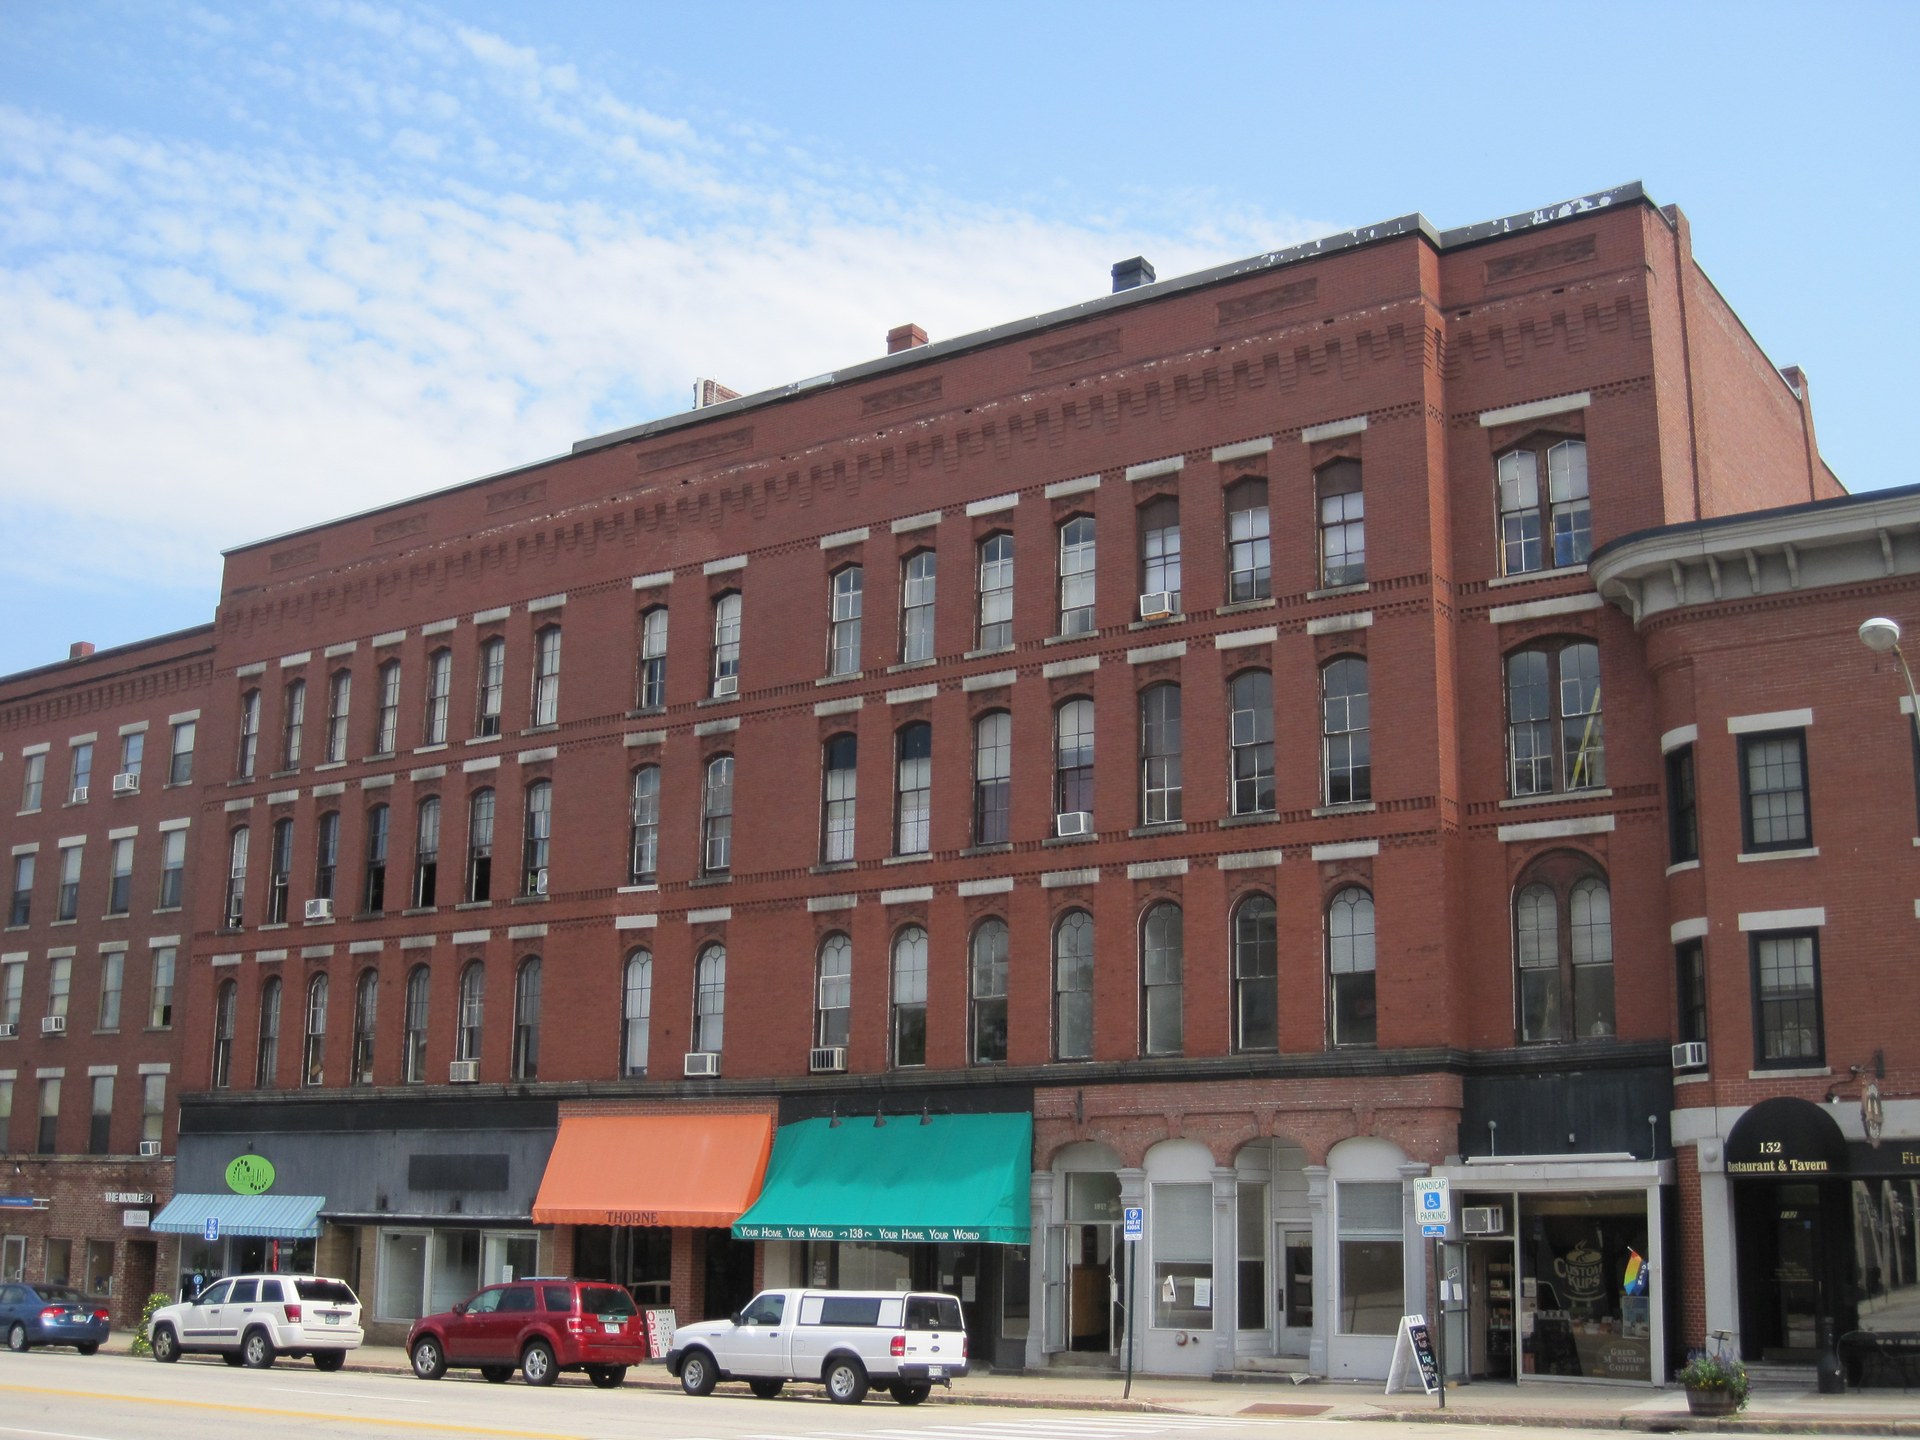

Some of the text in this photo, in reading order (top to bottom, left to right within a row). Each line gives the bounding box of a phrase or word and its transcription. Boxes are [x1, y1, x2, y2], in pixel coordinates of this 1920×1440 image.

[1759, 1142, 1781, 1153] 132
[1727, 1159, 1828, 1173] Restaurant & Tavern
[1416, 1180, 1446, 1190] HANDICAP
[105, 1192, 119, 1203] THE
[605, 1211, 658, 1224] THORNE
[1420, 1211, 1447, 1220] PARKING
[646, 1311, 661, 1358] OPEN
